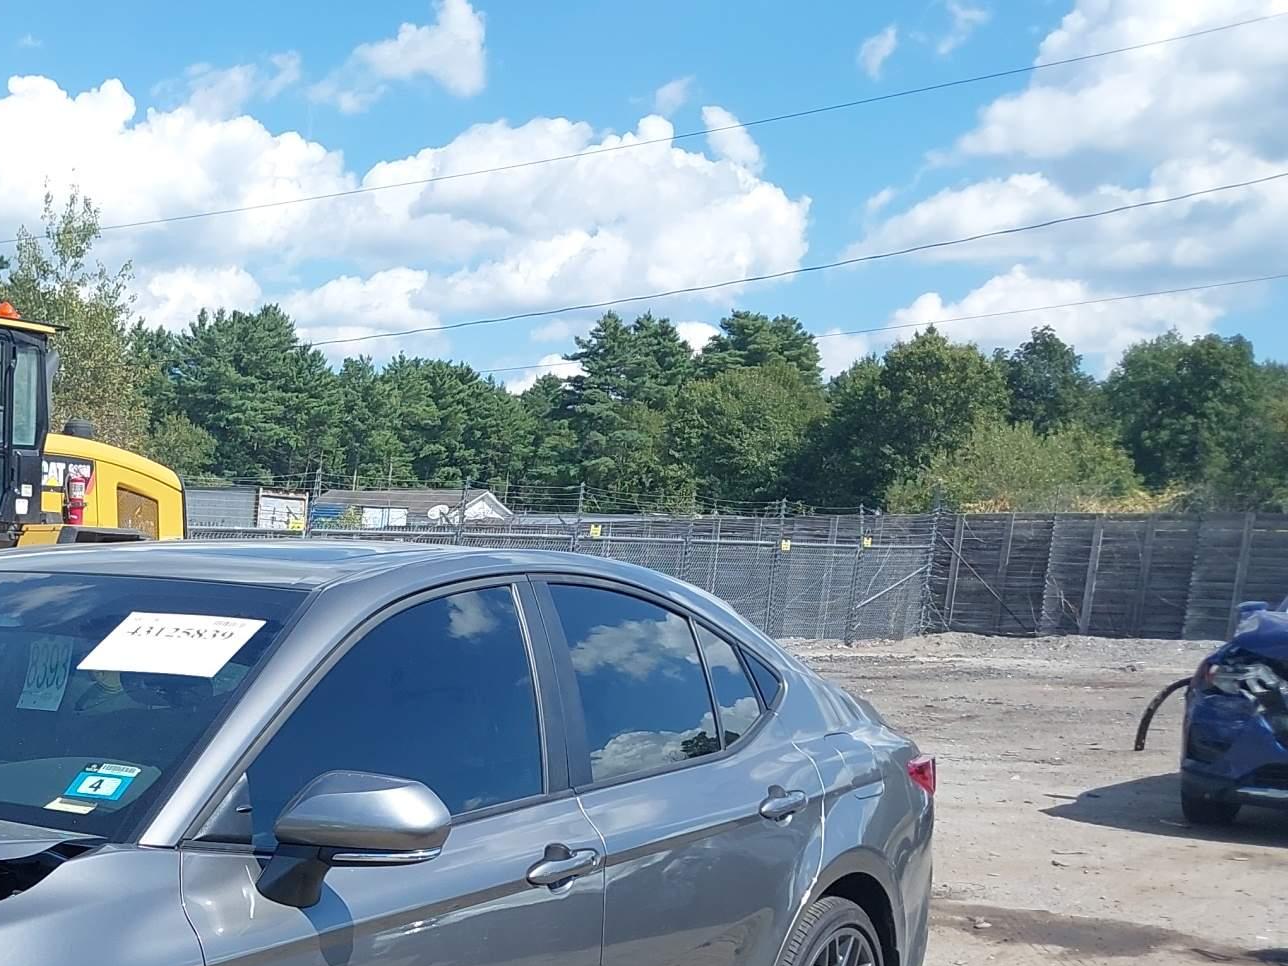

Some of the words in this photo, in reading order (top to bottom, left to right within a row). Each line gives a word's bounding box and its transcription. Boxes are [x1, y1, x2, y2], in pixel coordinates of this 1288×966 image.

[41, 460, 66, 487] CAT
[127, 625, 234, 640] 43125839
[88, 778, 104, 792] 4
